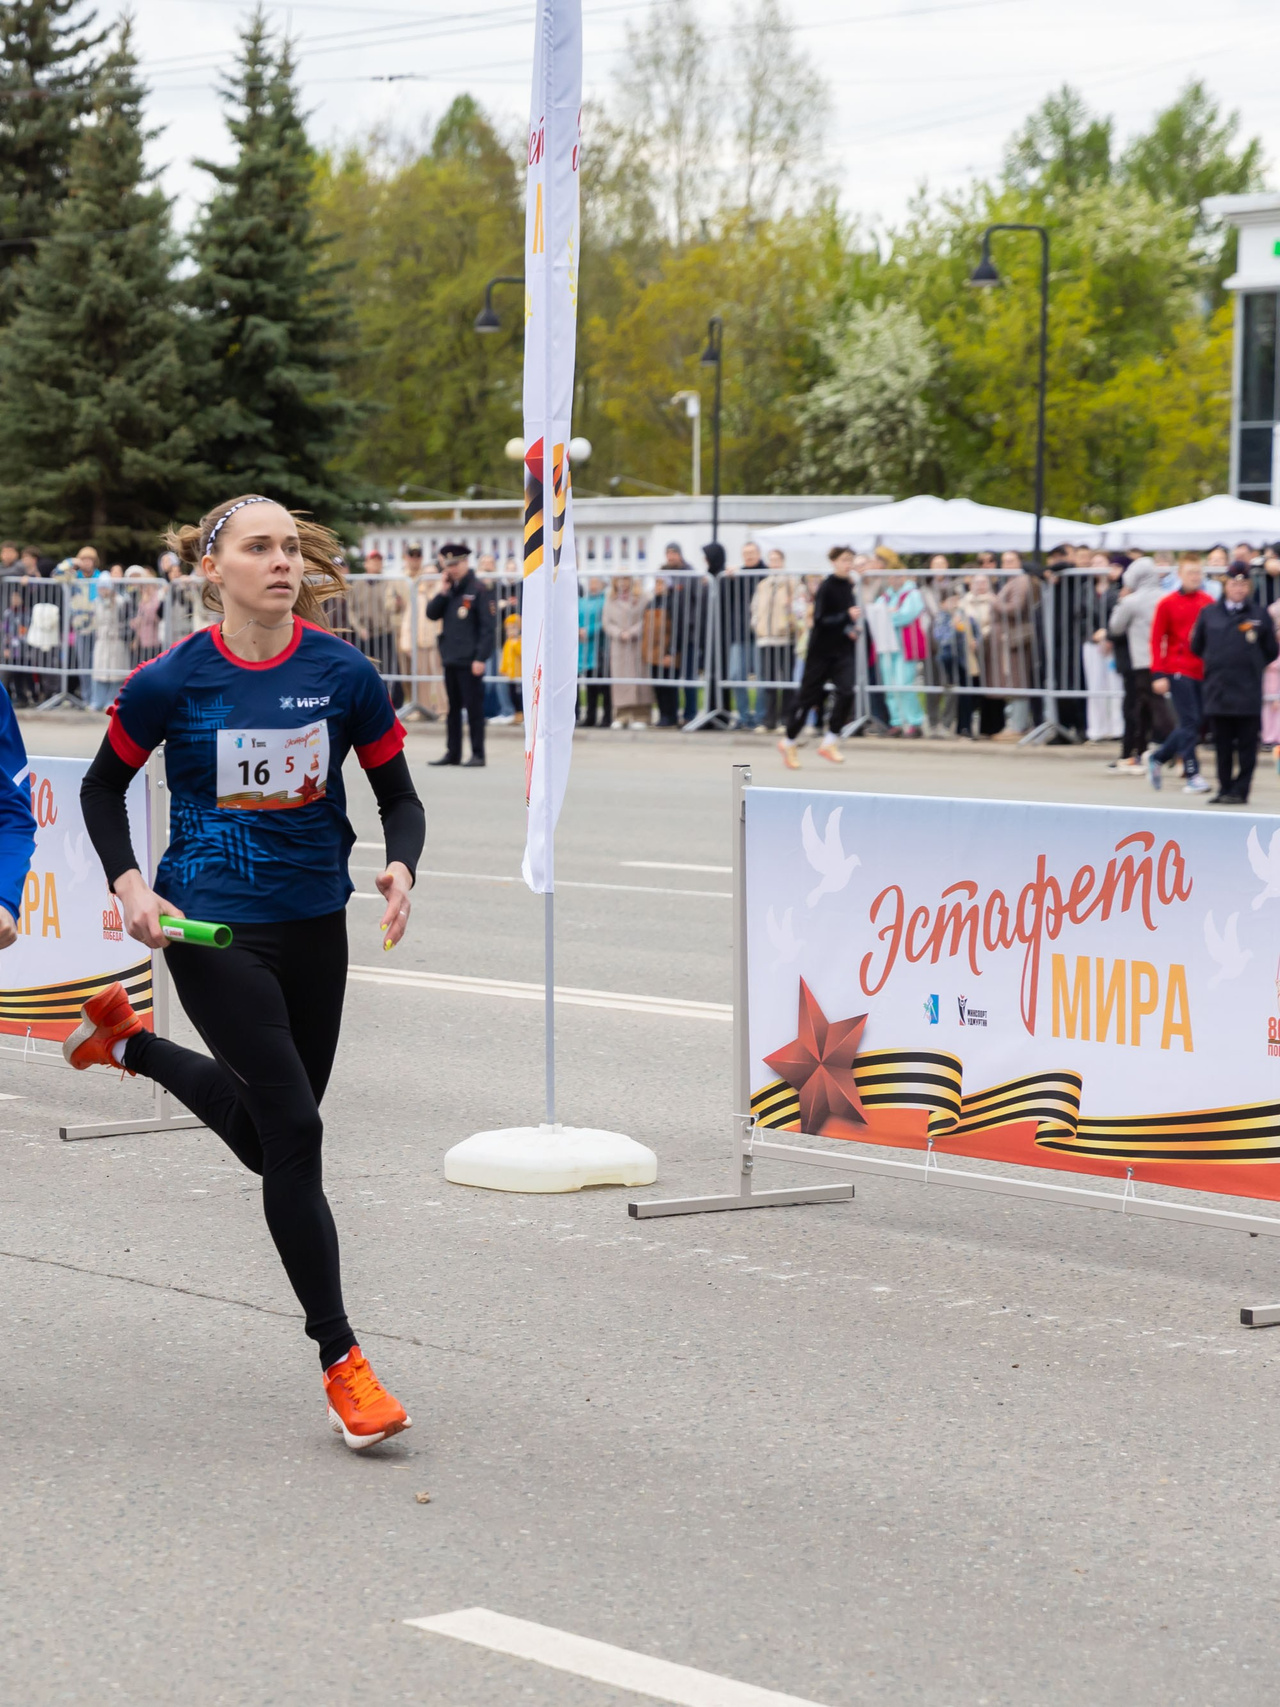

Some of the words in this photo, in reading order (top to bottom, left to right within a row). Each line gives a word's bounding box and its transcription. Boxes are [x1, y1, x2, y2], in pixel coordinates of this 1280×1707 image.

[296, 695, 331, 708] ИРЗ
[238, 759, 270, 786] 16
[285, 756, 295, 774] 5
[103, 910, 114, 928] 80
[859, 831, 1193, 1036] Эстафета
[1052, 953, 1194, 1053] МИРА
